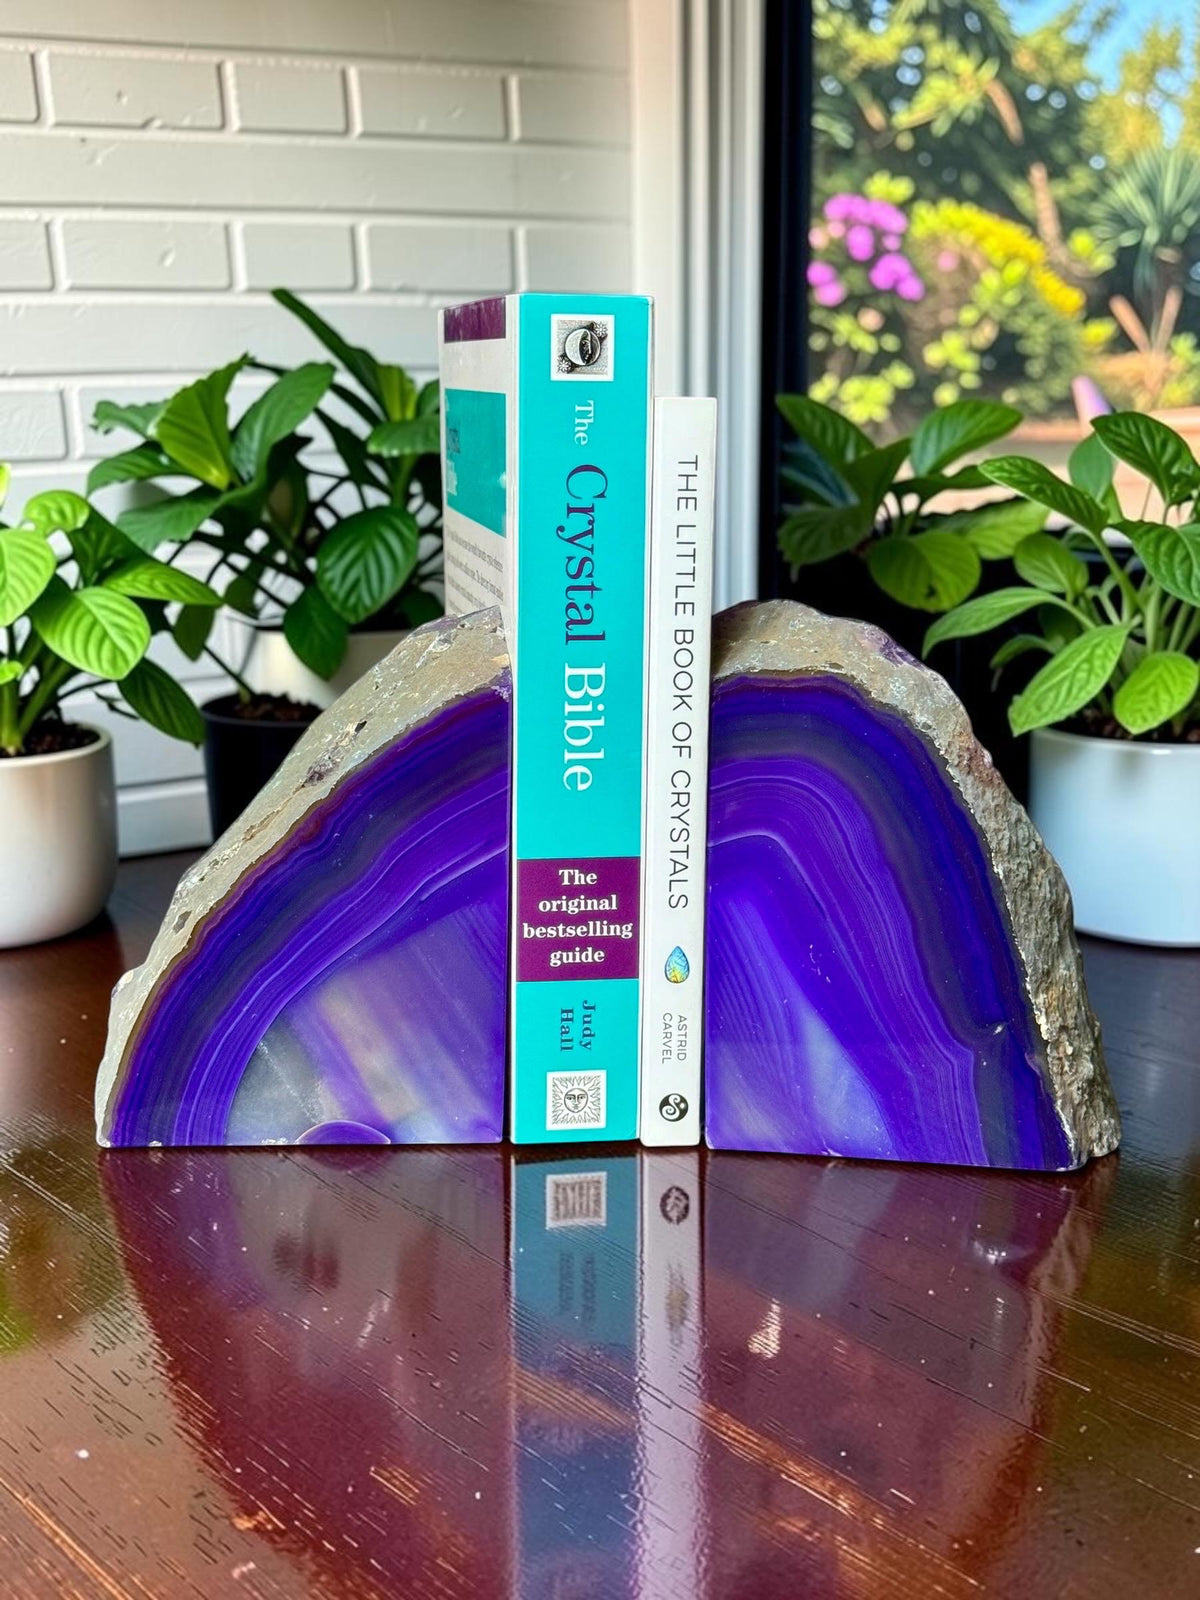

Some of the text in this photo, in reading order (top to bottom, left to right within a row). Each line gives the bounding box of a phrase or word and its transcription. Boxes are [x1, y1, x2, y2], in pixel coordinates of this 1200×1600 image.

[556, 400, 608, 791] The Crystal Bible
[668, 455, 698, 909] THE LITTLE BOOK OF CRYSTALS
[559, 869, 598, 886] The
[538, 895, 618, 914] original
[522, 921, 633, 939] bestselling
[549, 947, 605, 967] guide
[560, 1007, 574, 1052] Hall
[580, 1000, 597, 1051] Judy
[662, 1012, 673, 1064] CARVEL
[677, 1014, 687, 1061] ASTRID
